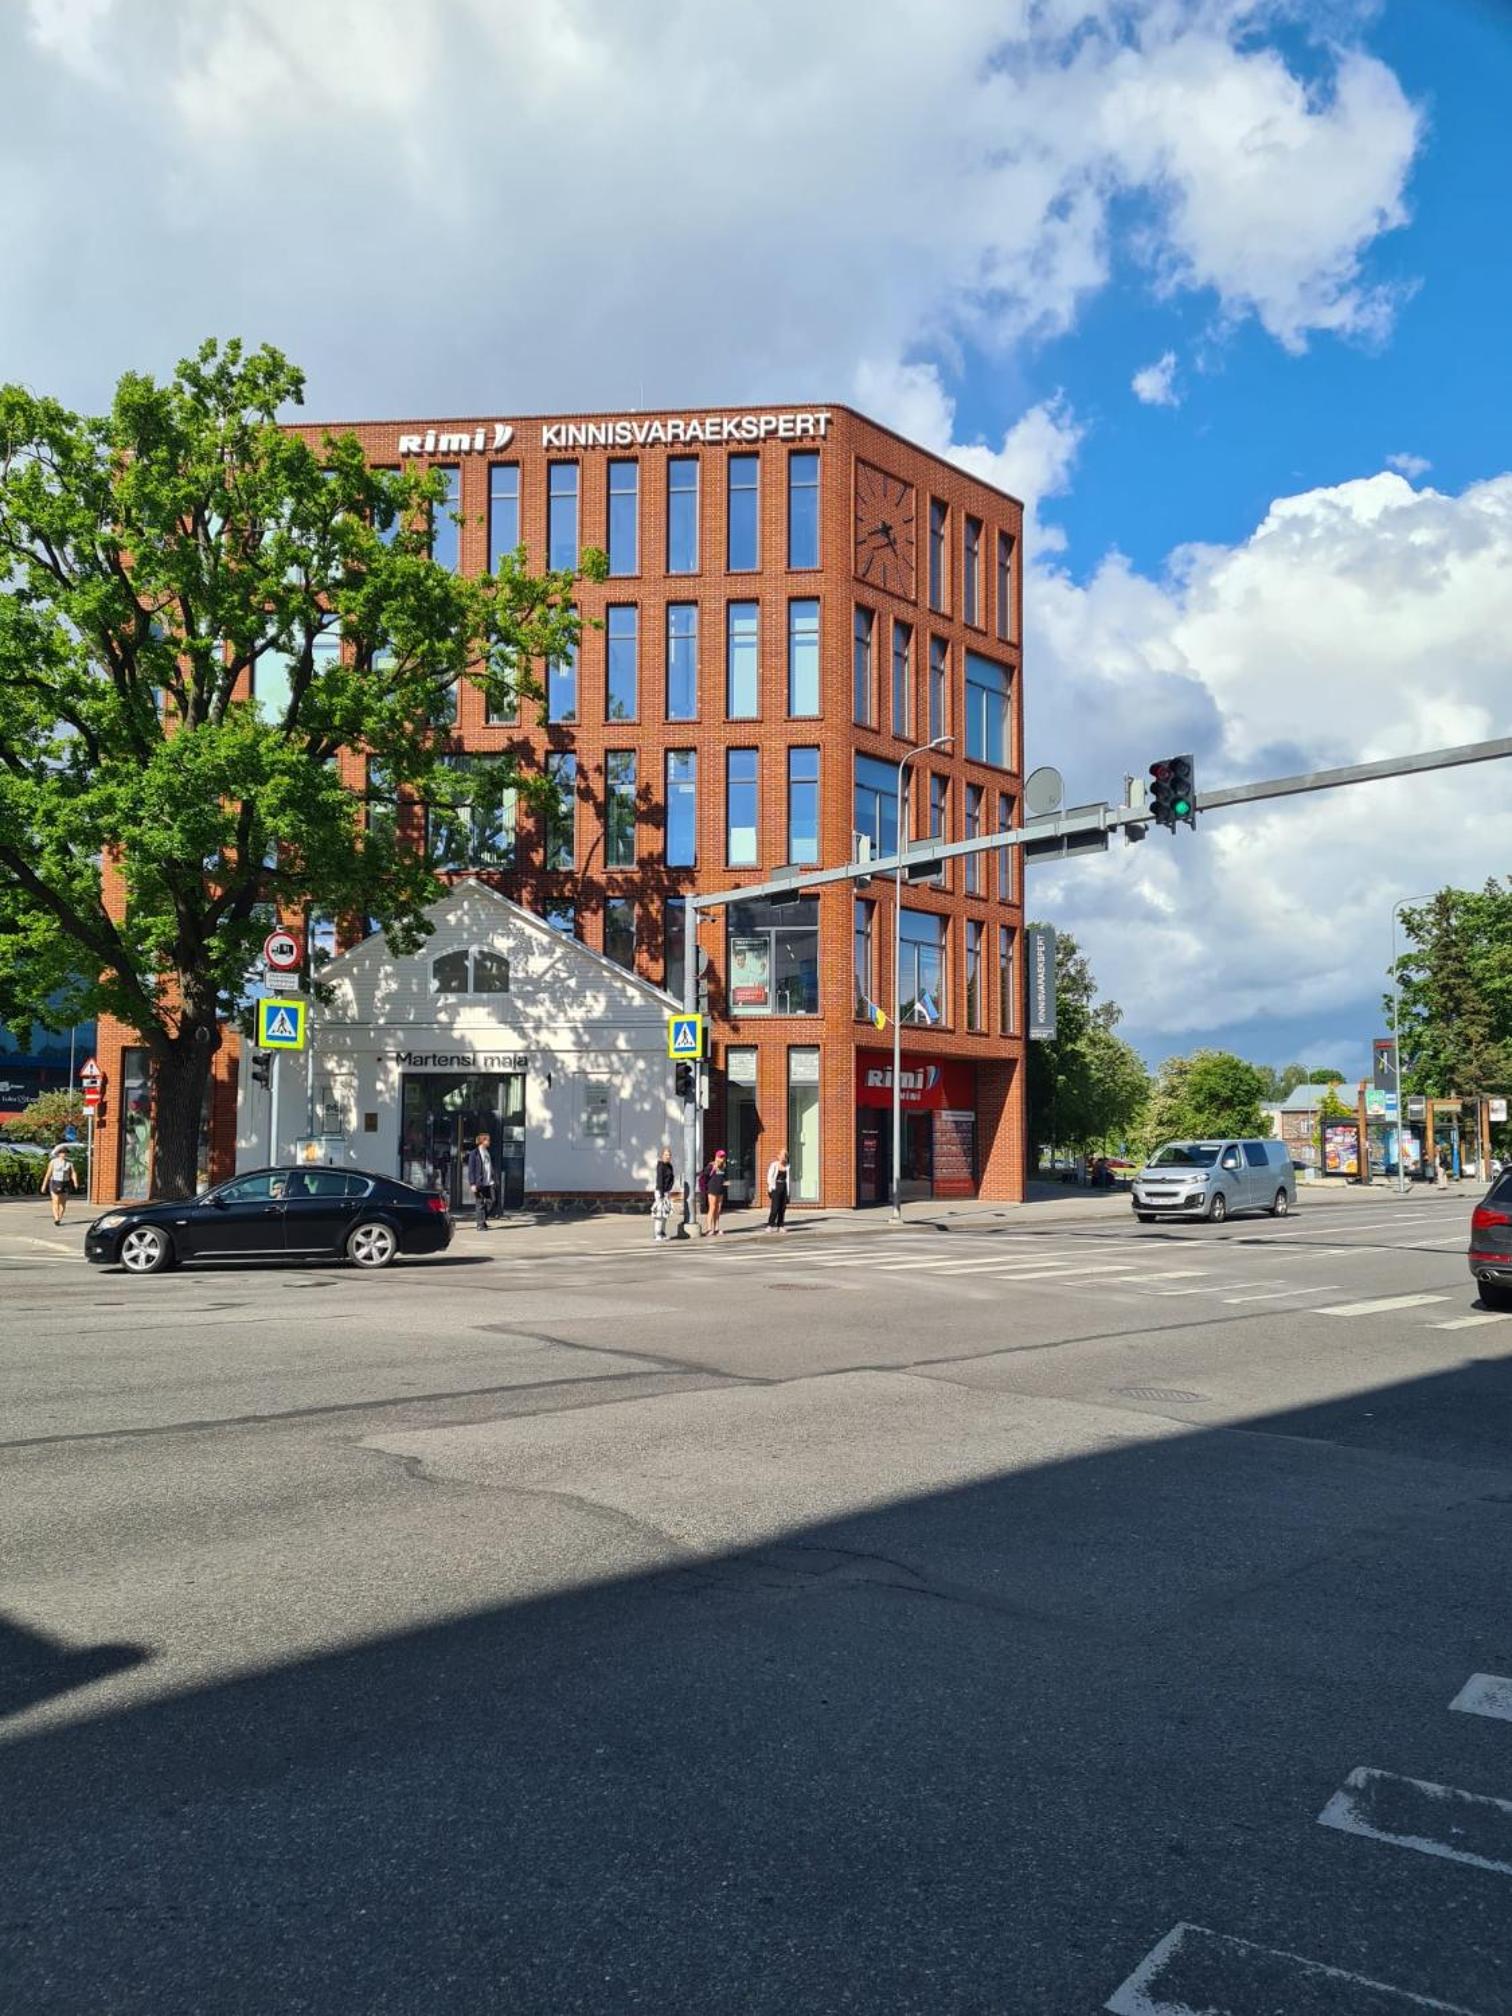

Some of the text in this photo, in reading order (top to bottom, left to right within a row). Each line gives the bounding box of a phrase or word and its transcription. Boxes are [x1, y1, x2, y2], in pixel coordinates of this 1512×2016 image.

[399, 428, 486, 451] Rimi
[541, 412, 832, 447] KINNISVARAEKSPERT
[1036, 934, 1046, 1024] KINNISVARAEKSPERT
[396, 1052, 528, 1071] Martensi maja
